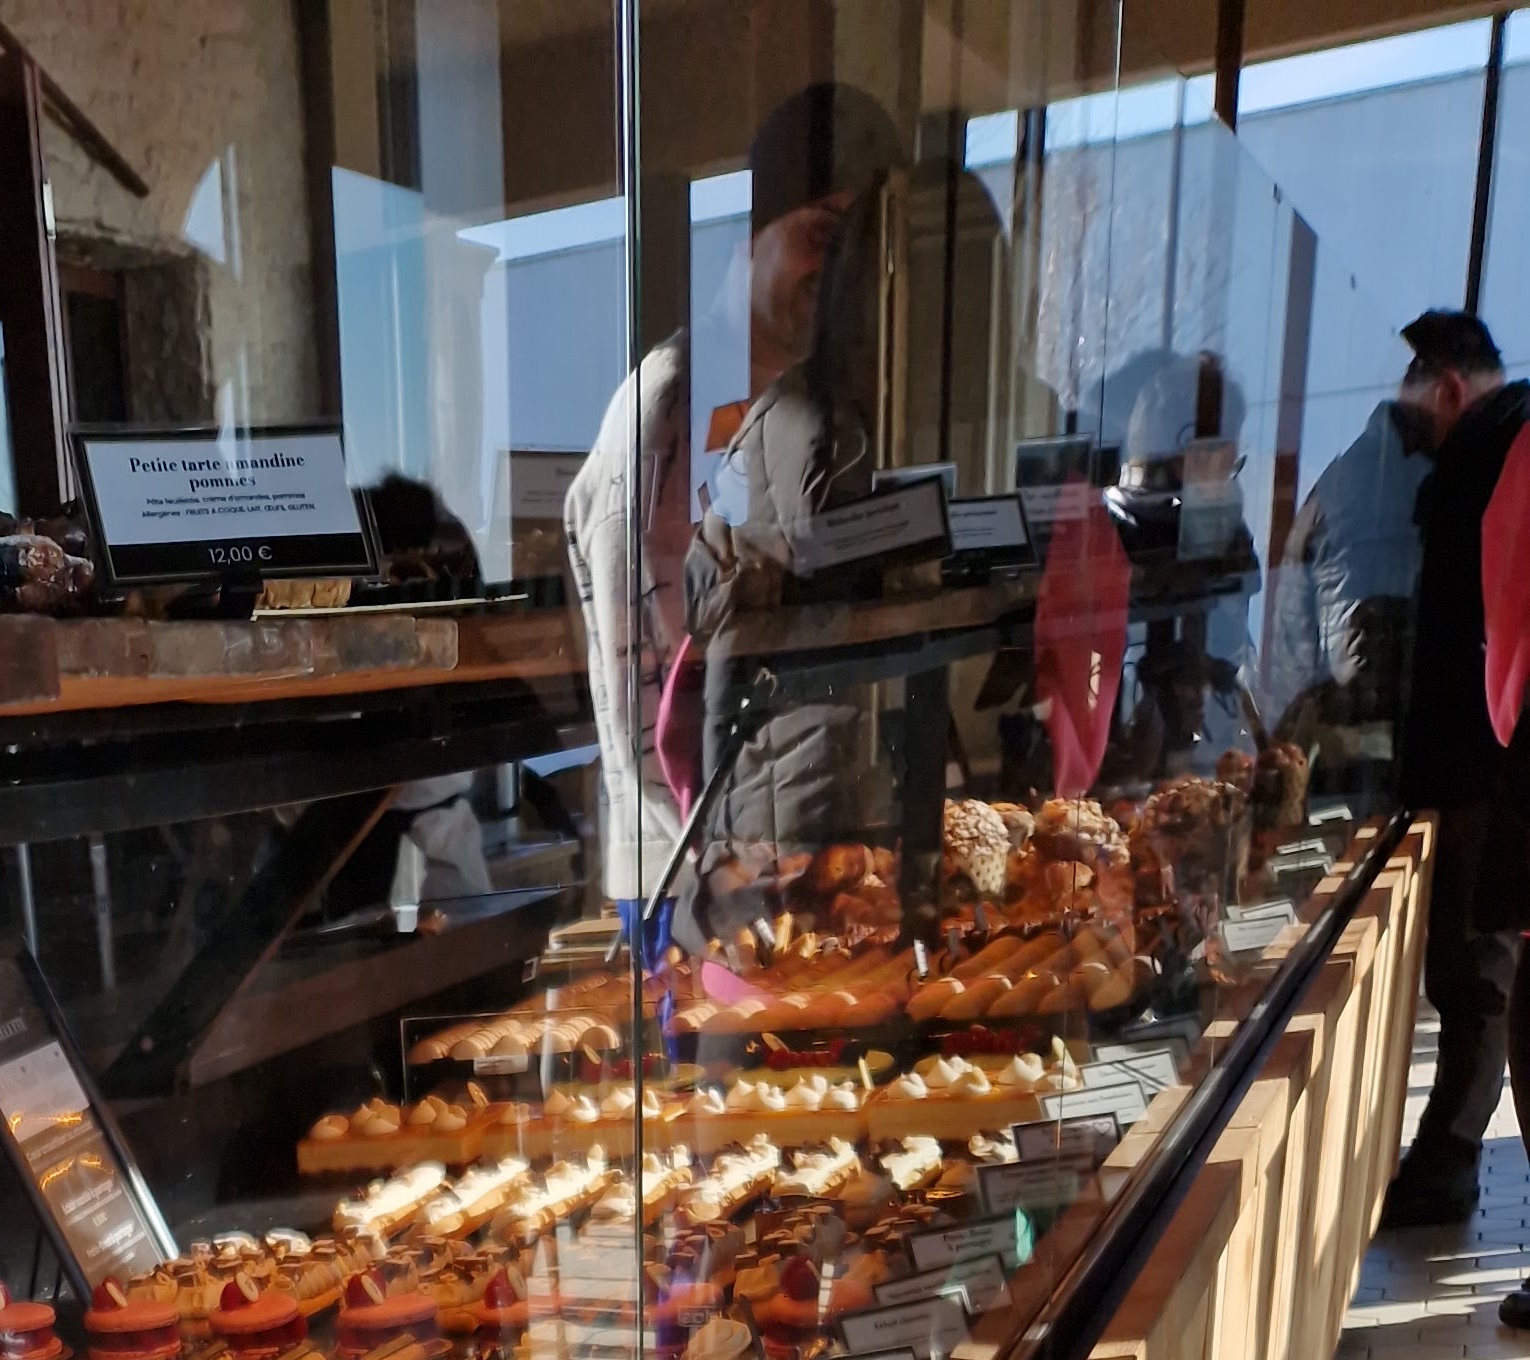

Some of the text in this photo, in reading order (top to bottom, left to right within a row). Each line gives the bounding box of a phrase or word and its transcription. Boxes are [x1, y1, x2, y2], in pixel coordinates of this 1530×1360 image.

[129, 456, 178, 474] Petite
[182, 457, 221, 473] tarte
[208, 545, 273, 567] 12,00 €
